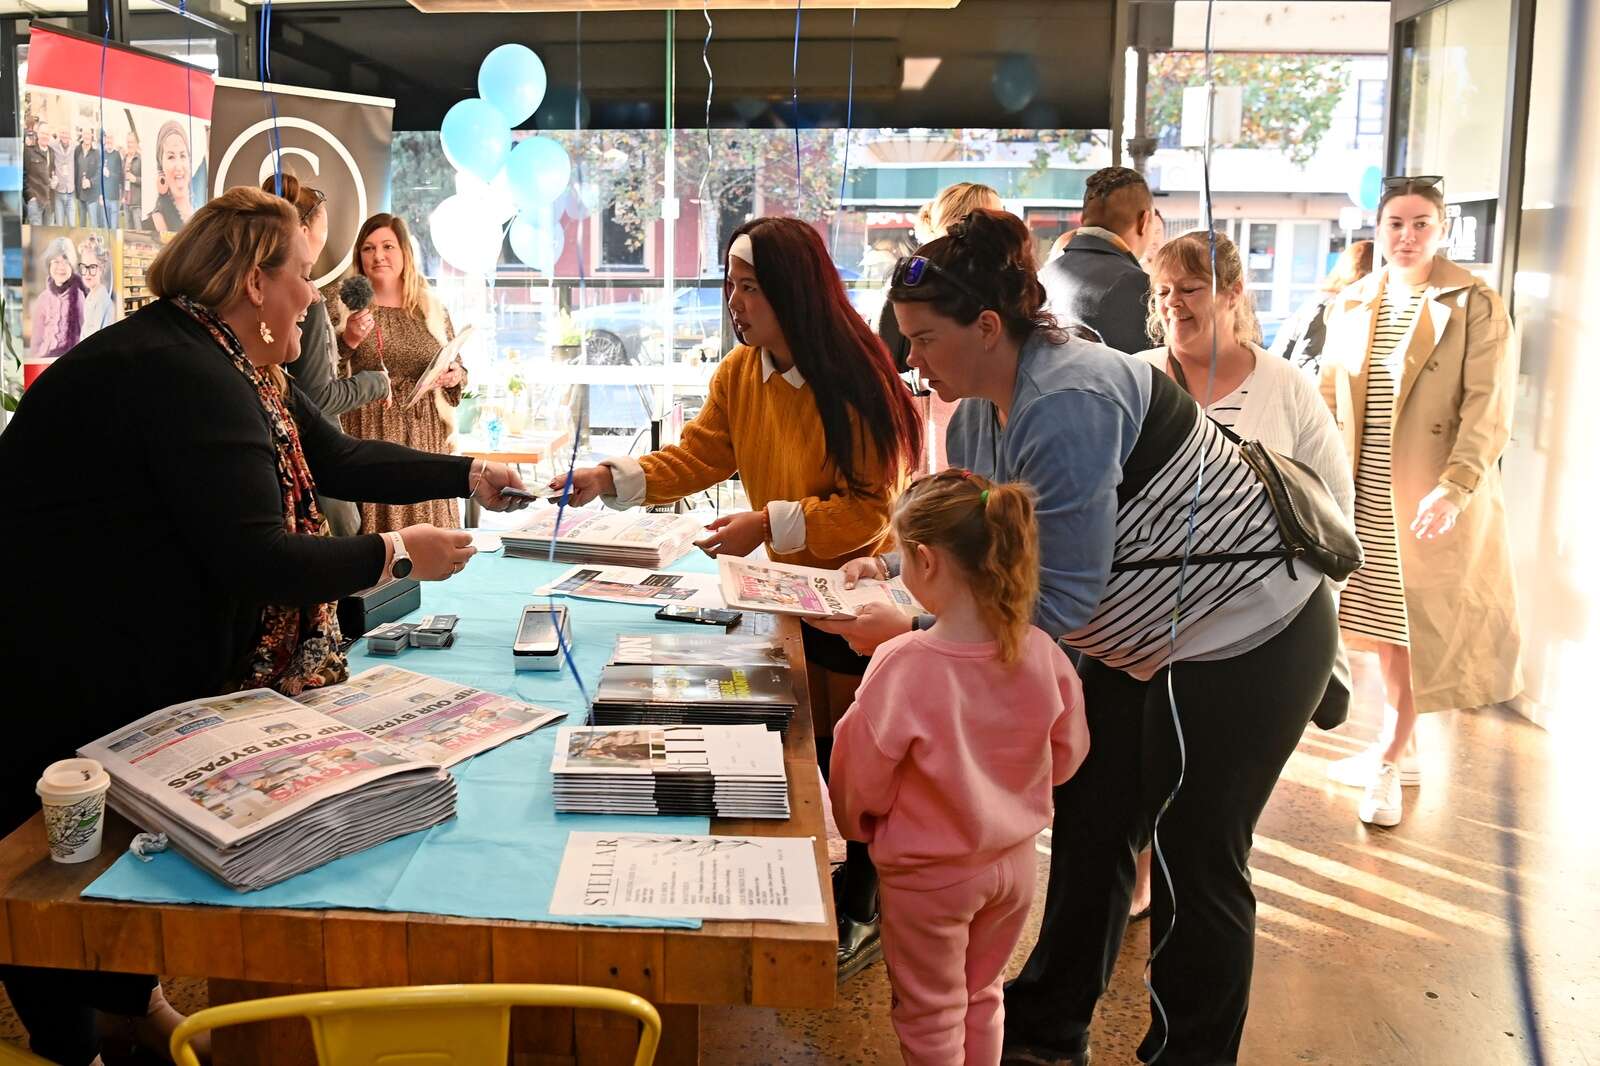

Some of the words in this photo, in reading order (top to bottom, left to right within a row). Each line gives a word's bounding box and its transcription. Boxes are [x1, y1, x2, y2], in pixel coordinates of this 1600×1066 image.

[416, 699, 452, 715] OUR
[363, 713, 417, 736] BYPAS
[263, 733, 312, 748] OUR
[168, 745, 262, 789] BYPASS
[584, 839, 618, 906] STELLAR
